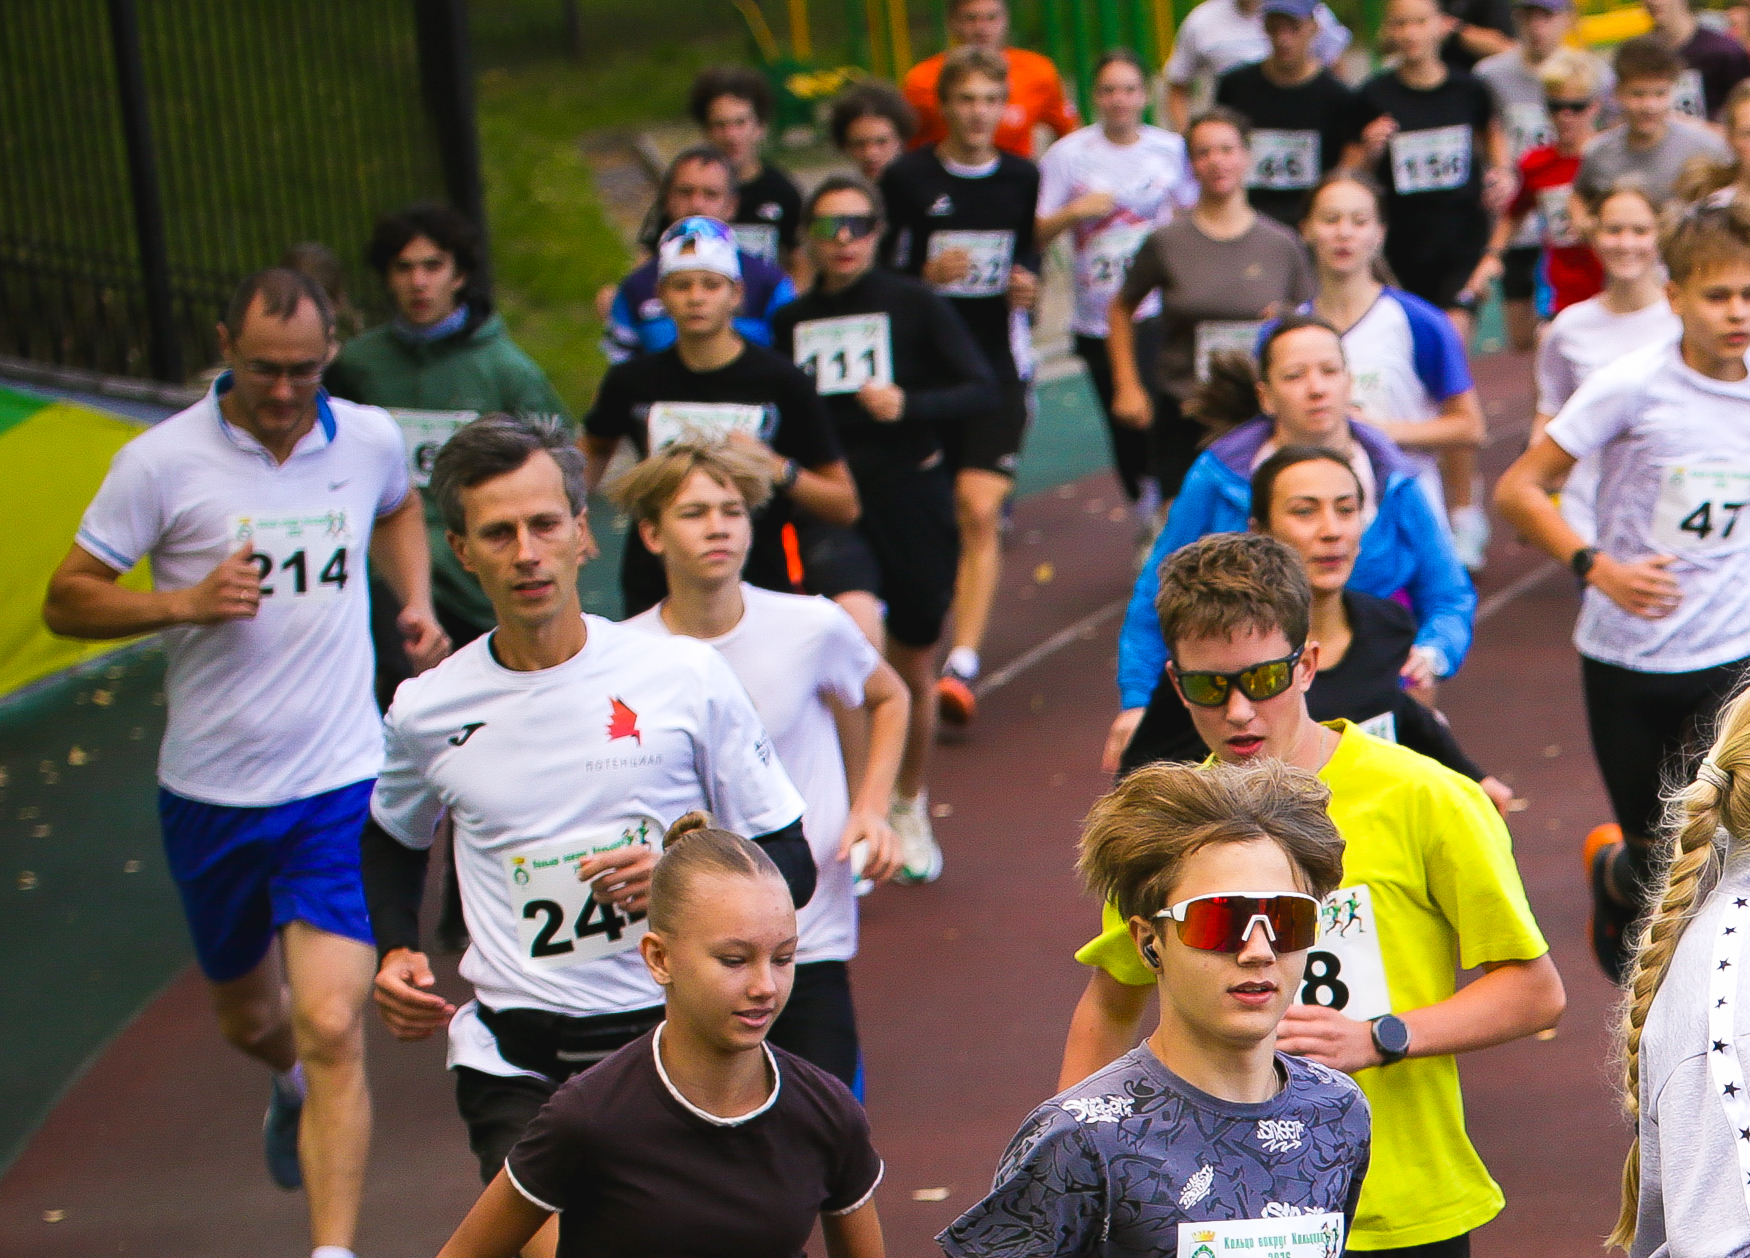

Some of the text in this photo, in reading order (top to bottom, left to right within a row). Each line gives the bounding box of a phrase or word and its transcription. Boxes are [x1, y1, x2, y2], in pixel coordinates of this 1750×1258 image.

[1679, 501, 1748, 539] 47
[244, 546, 348, 594] 214
[522, 890, 648, 958] 24
[1223, 1237, 1255, 1250] Кольцо
[1258, 1235, 1287, 1249] вокруг
